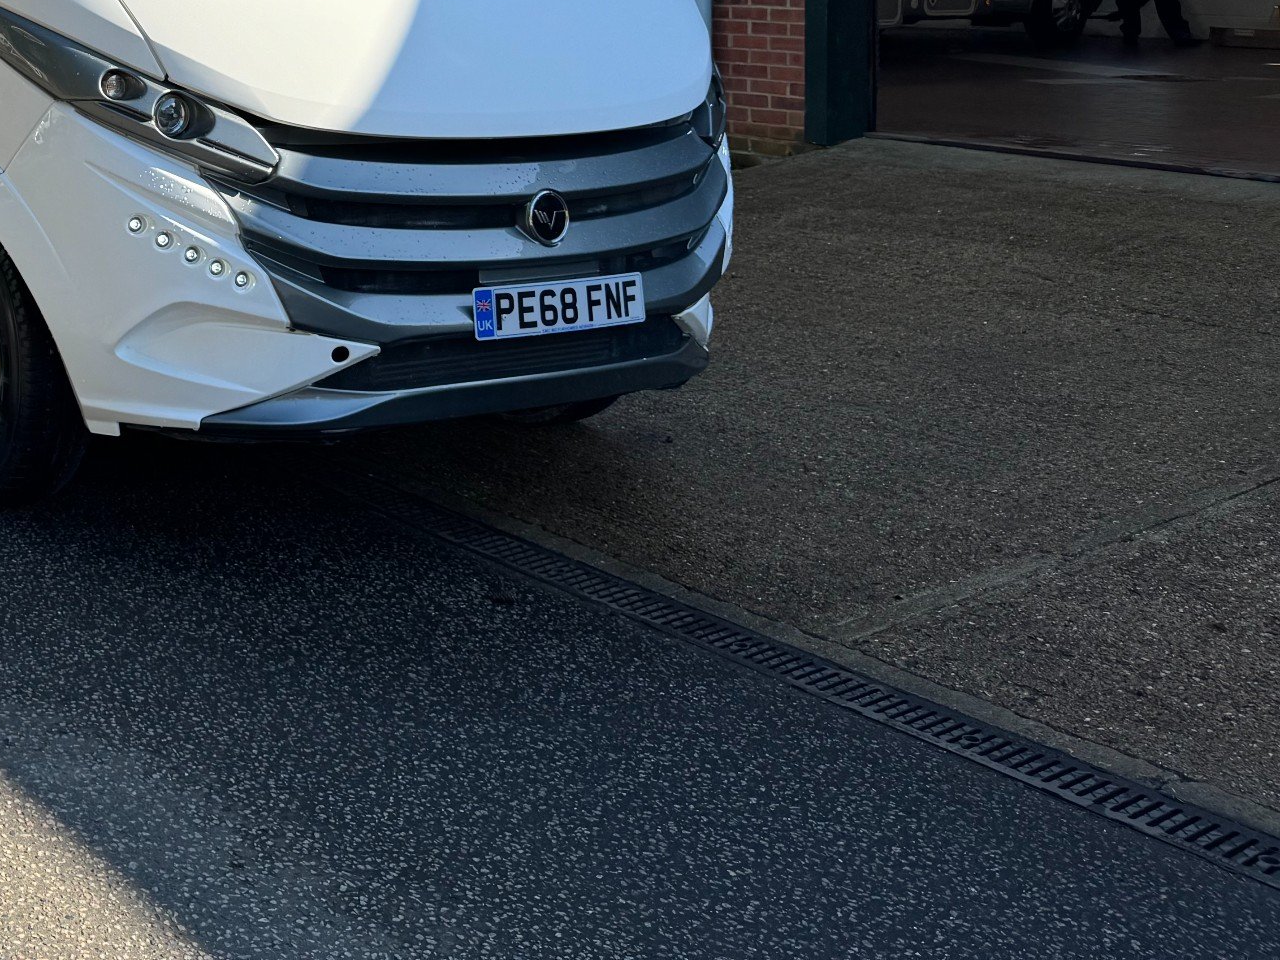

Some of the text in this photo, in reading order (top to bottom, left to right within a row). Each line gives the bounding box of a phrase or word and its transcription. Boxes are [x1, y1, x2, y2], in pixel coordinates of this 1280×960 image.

[495, 279, 637, 331] PE68 FNF
[477, 319, 493, 332] UK
